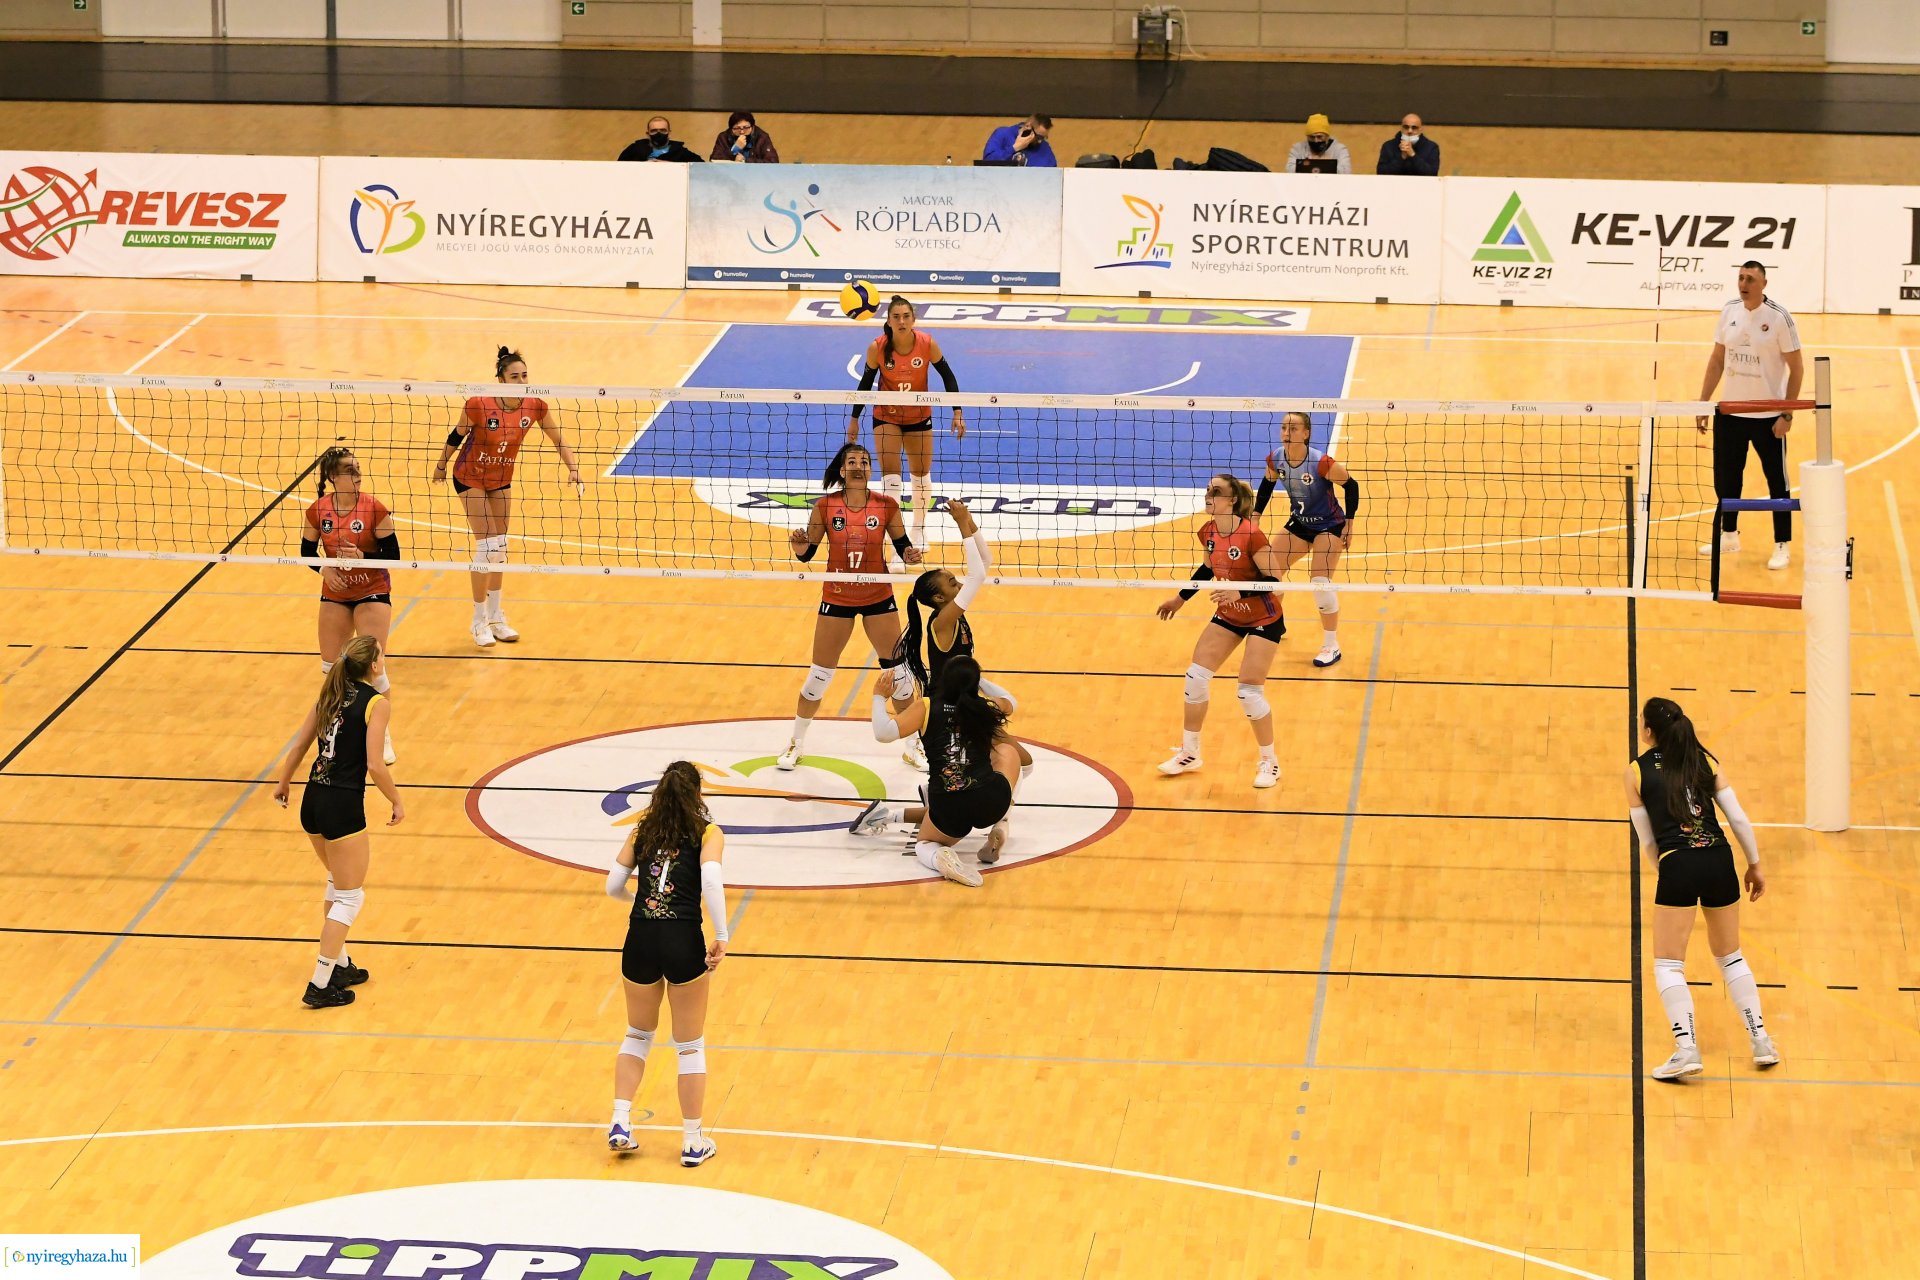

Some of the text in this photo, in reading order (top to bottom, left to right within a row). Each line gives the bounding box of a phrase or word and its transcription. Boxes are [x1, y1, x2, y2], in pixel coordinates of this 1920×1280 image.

[902, 195, 954, 206] MAGYAR
[97, 190, 287, 228] REVESZ
[1193, 198, 1369, 226] NYÍREGYHÁZI
[436, 207, 654, 240] NYÍREGYHÁZA
[856, 206, 1001, 233] RÖPLABDA
[1571, 212, 1797, 250] KE-VIZ 21
[127, 233, 273, 247] ALWAYS ON THE RIGHT WAY
[894, 237, 960, 250] SZÖVETSÉG
[1191, 233, 1409, 259] SPORTCENTRUM
[436, 241, 654, 256] MEGYEI JOGÚ VÁROS ÖNKORMÁNYZATA
[1191, 260, 1409, 277] Nyíregyházi Sportcentrum Nonprofit Kft.
[1660, 256, 1704, 272] ZRT.
[722, 270, 749, 278] hunvolley
[789, 271, 815, 280] hunvolley
[939, 274, 965, 282] hunvolley
[1473, 265, 1553, 279] KE-VIZ 21
[1700, 282, 1724, 292] 1991
[897, 382, 912, 392] 12
[847, 551, 863, 569] 17
